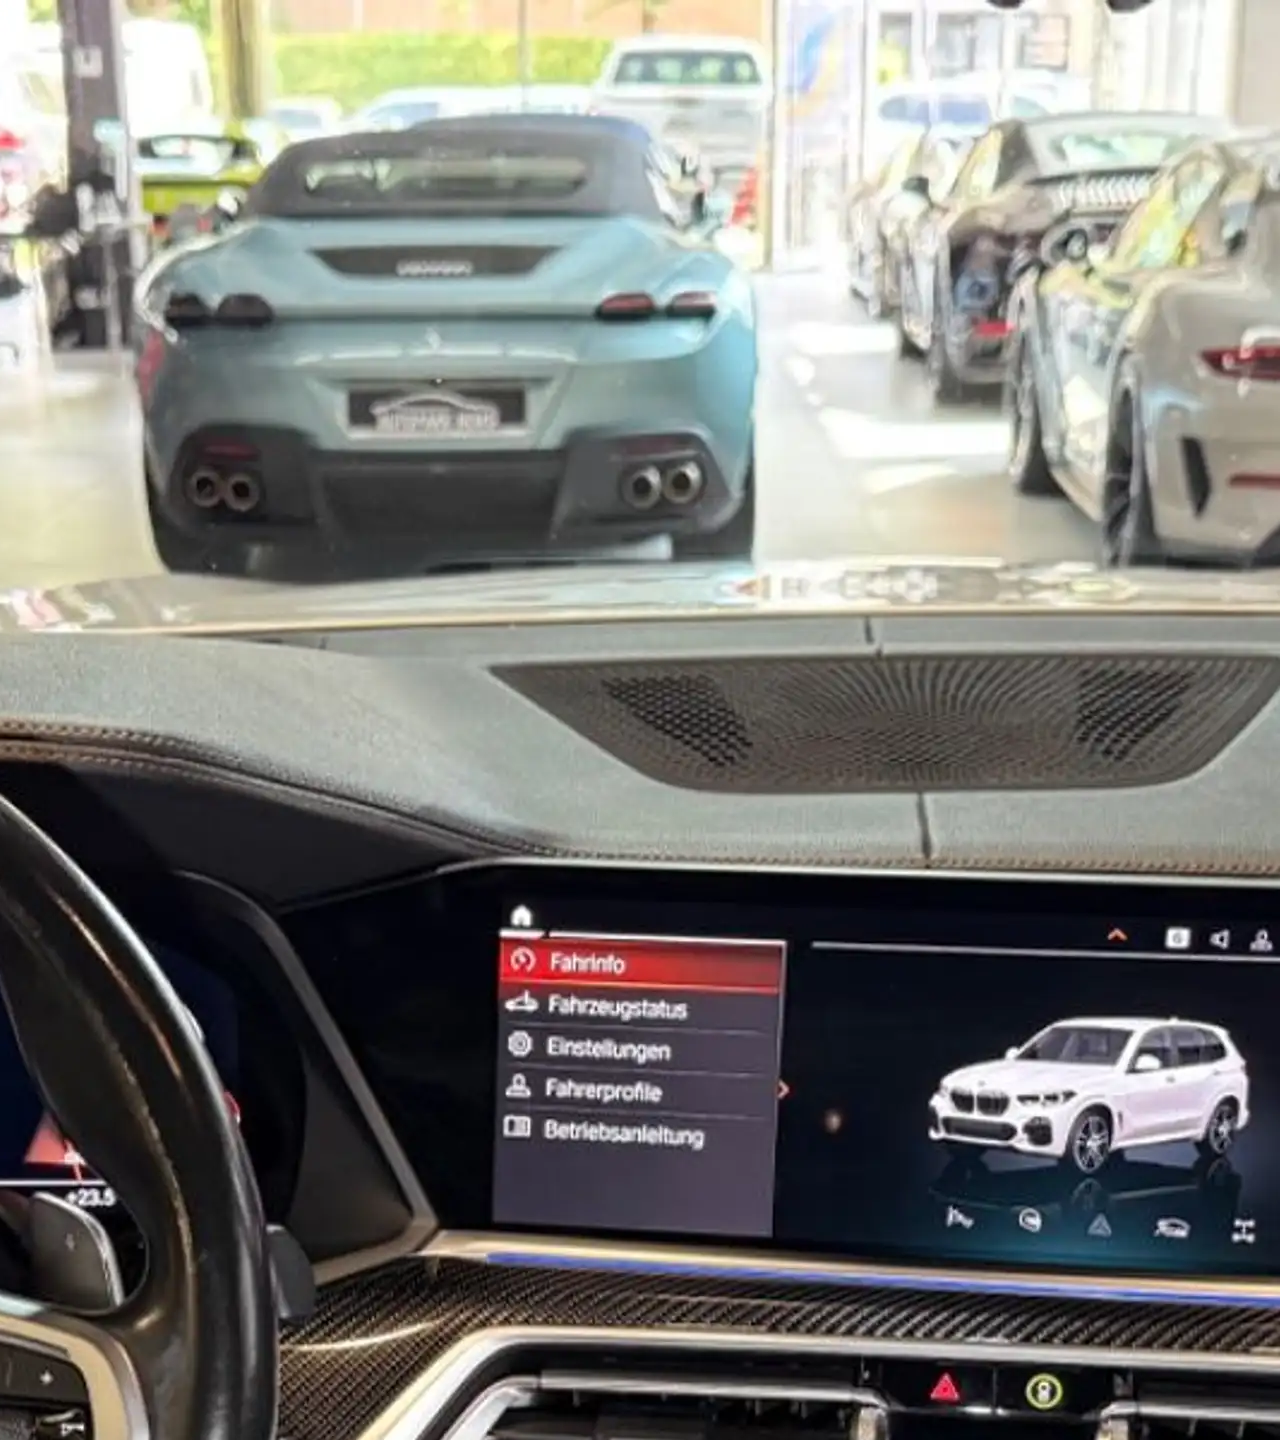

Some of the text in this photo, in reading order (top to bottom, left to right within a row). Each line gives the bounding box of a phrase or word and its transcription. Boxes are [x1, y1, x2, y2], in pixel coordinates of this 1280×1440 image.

[549, 950, 626, 975] Fahrinfo
[548, 994, 688, 1023] Fahrzeugstatus
[547, 1034, 671, 1064] Einstellungen
[545, 1077, 663, 1104] Fahrerprofile
[544, 1119, 705, 1151] Betriebsanleitung
